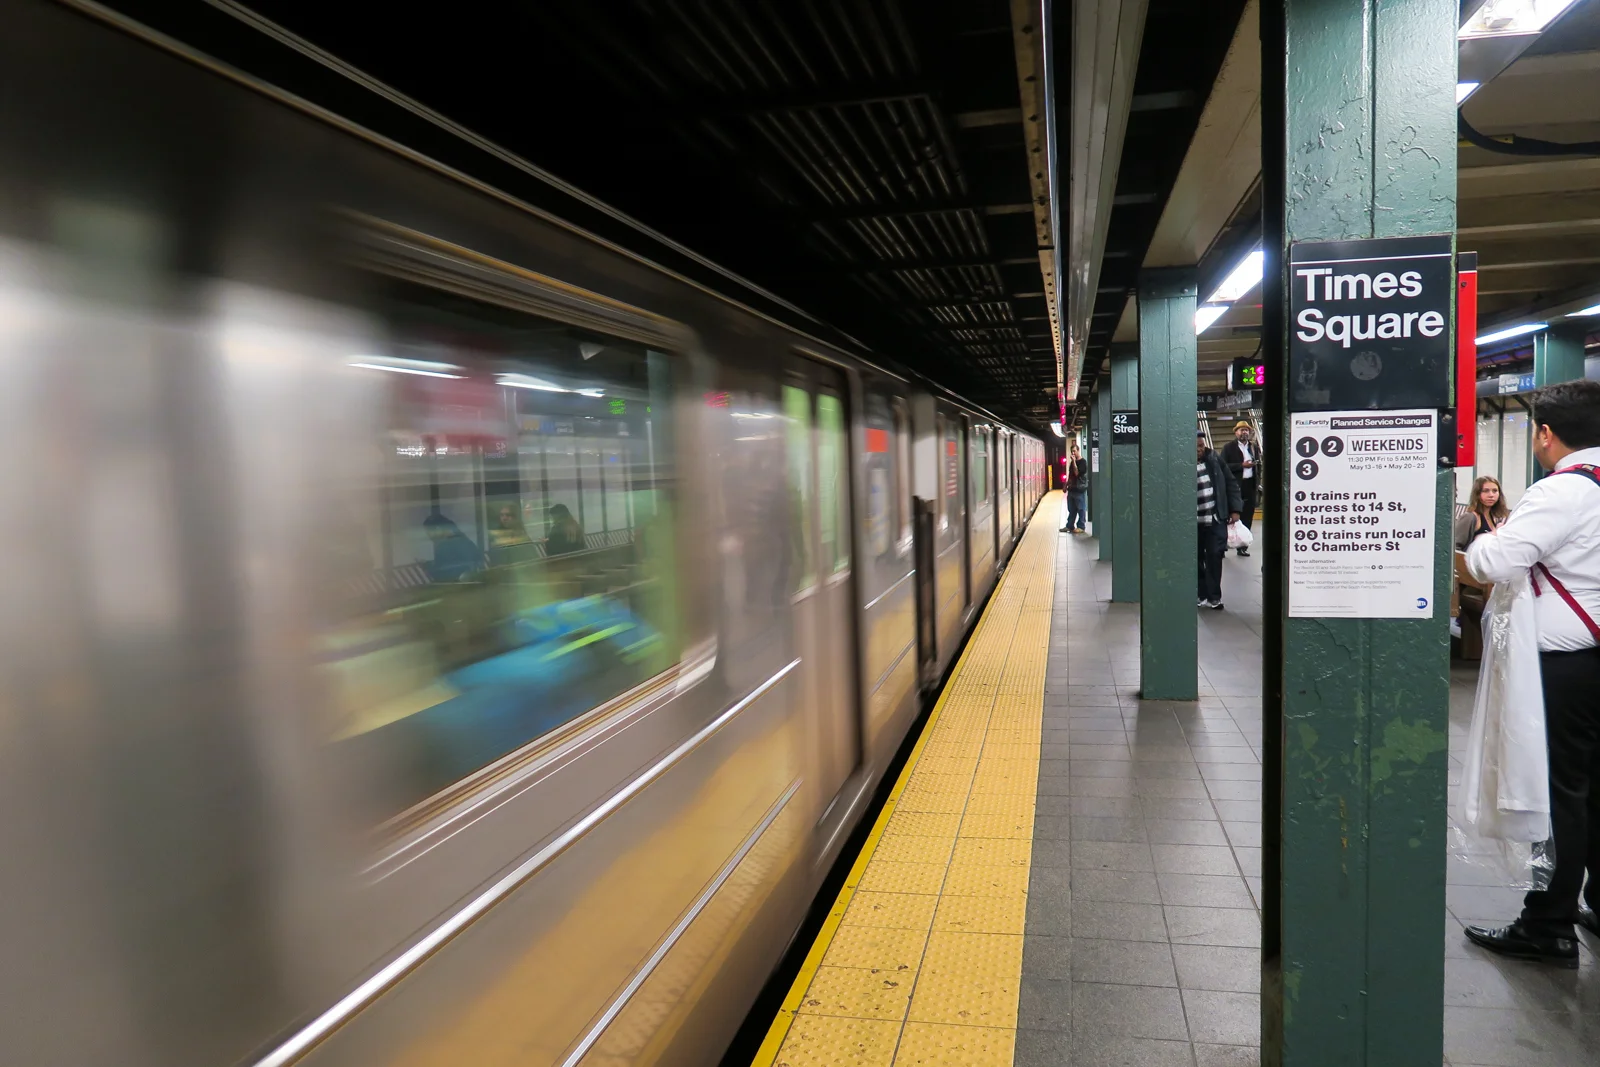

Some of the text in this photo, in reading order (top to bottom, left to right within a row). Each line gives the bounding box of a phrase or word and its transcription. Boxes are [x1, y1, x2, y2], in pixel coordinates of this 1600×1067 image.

[1297, 268, 1423, 302] Times
[1296, 308, 1444, 348] Square
[1113, 414, 1128, 424] 42
[1332, 417, 1430, 427] Planned Service Changes
[1113, 424, 1139, 433] Stree
[1351, 438, 1424, 452] WEEKENDS
[1310, 490, 1350, 501] trains
[1353, 491, 1377, 500] run
[1294, 501, 1406, 515] express to 14 St,
[1294, 515, 1379, 526] the last stop
[1321, 529, 1362, 540] trains
[1365, 530, 1389, 539] run
[1392, 528, 1426, 539] local
[1294, 541, 1401, 552] to Chambers St
